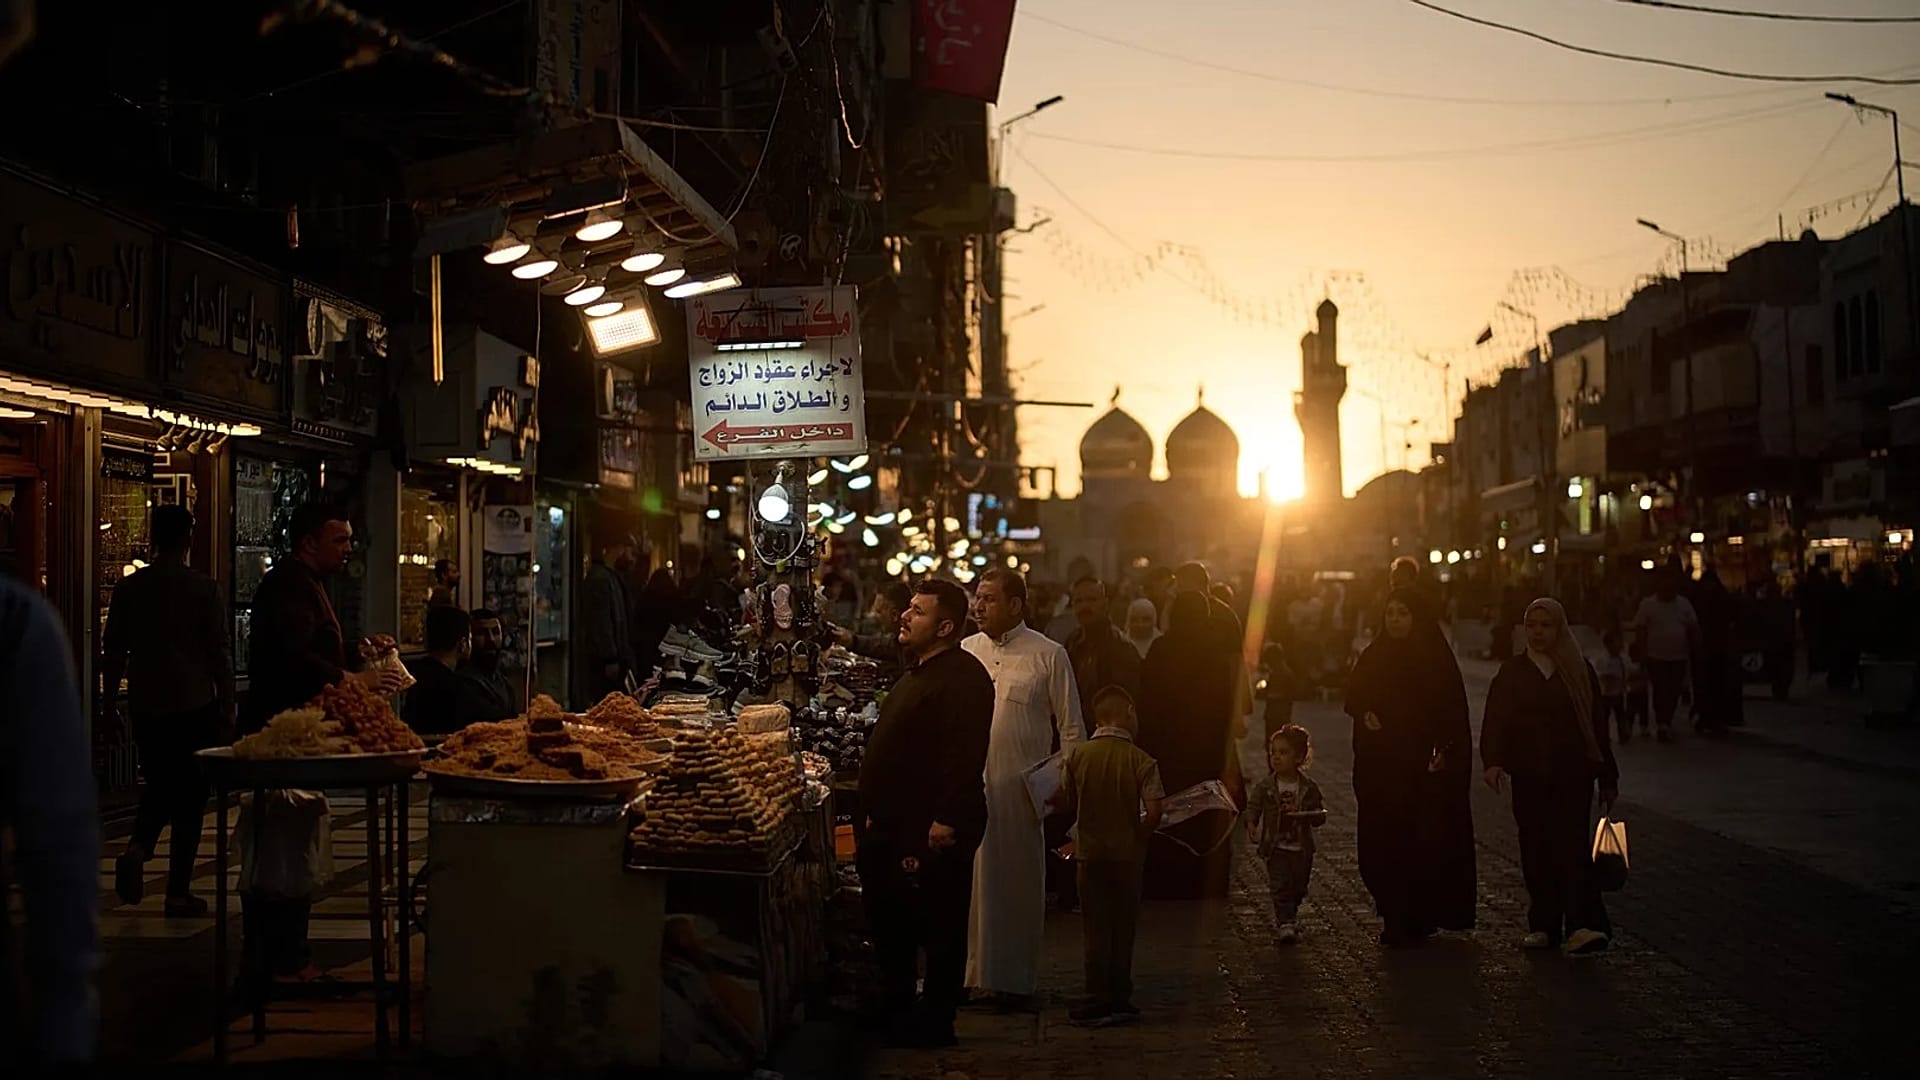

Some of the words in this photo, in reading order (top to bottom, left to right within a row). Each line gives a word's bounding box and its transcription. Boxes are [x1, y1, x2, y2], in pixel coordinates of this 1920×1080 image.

[780, 298, 852, 340] مكتب
[699, 361, 749, 387] الزواج
[754, 359, 796, 383] عقود
[705, 391, 767, 416] الدائم
[716, 428, 784, 443] الفرع
[790, 426, 844, 440] داخل
